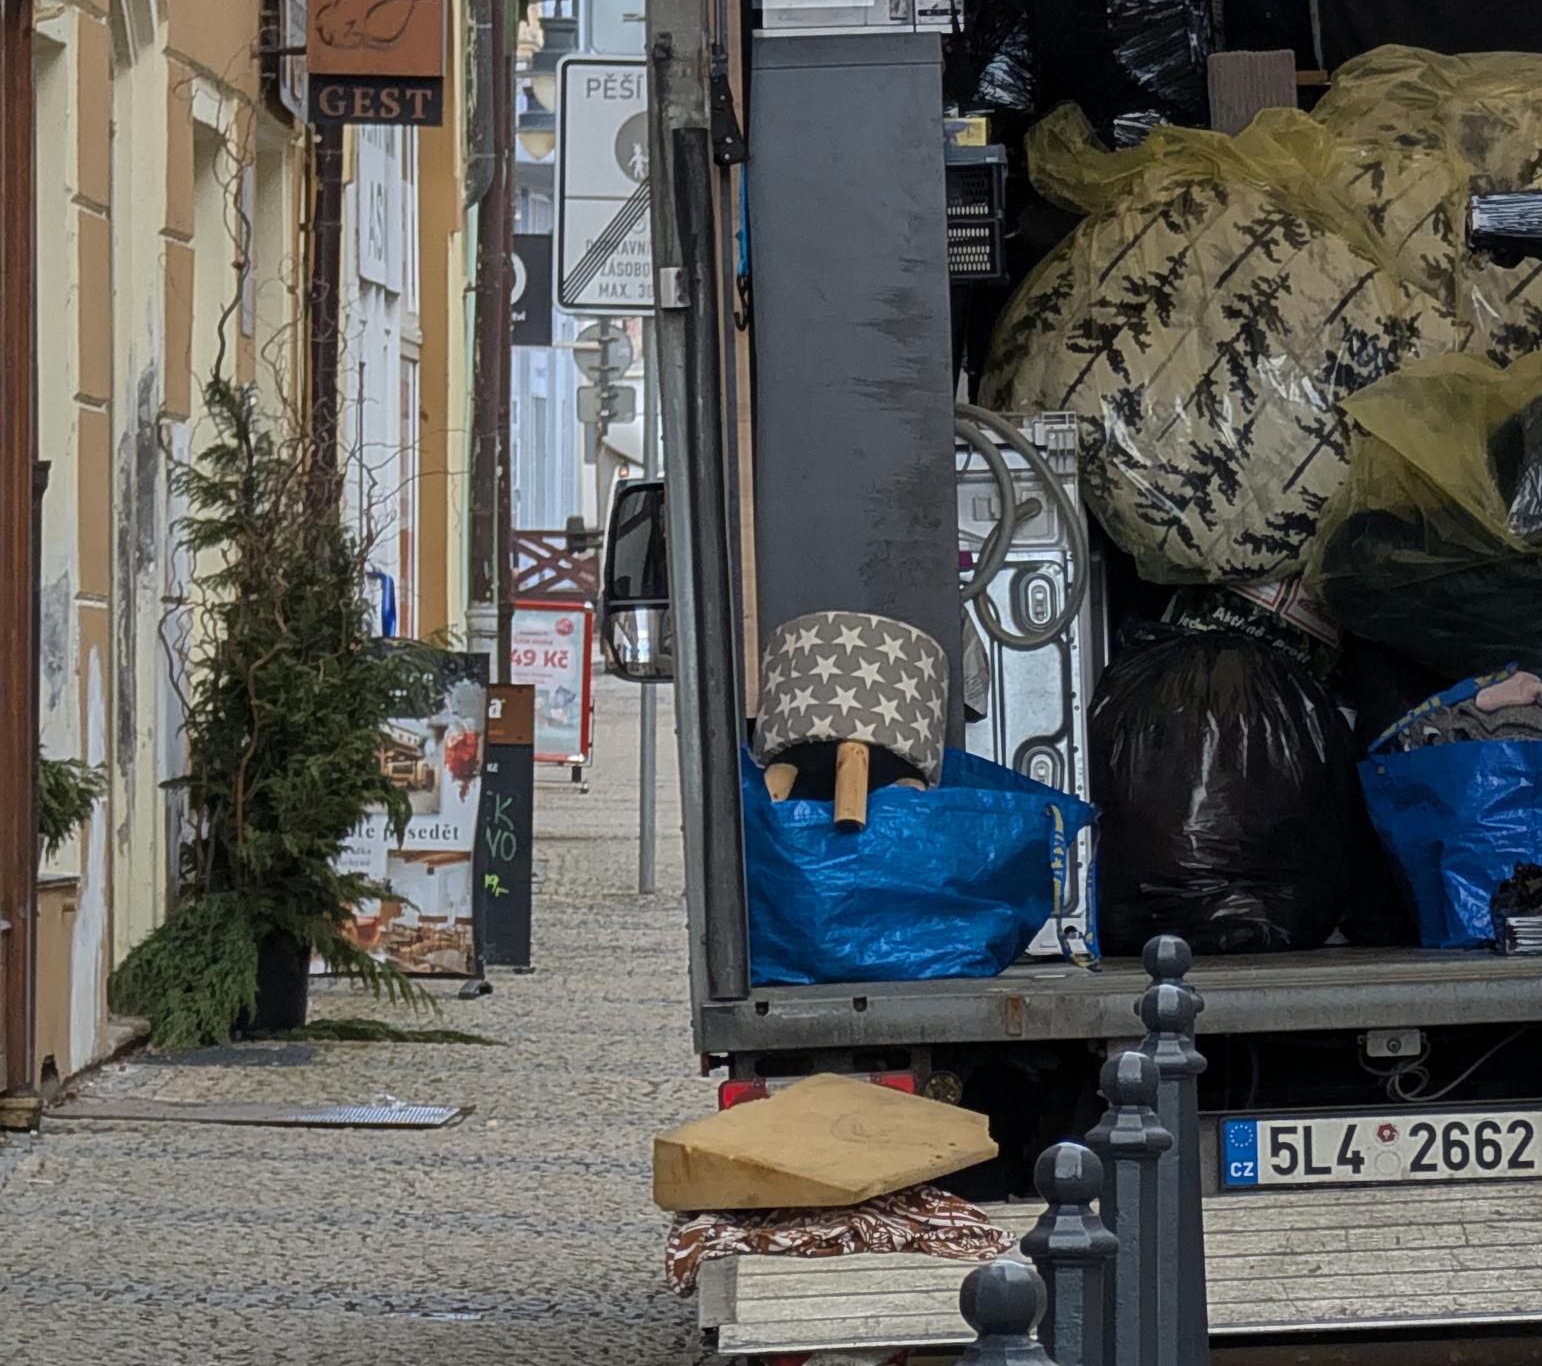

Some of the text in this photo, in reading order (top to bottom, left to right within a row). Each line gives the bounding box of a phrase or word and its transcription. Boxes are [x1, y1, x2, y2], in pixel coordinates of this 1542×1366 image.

[585, 72, 644, 99] PĚŠÍ
[318, 86, 433, 120] GEST
[598, 282, 631, 299] MAX.
[543, 649, 569, 669] Kč
[383, 823, 459, 843] psedět
[1269, 1119, 1536, 1176] 5L4 2662
[1229, 1161, 1255, 1177] CZ
